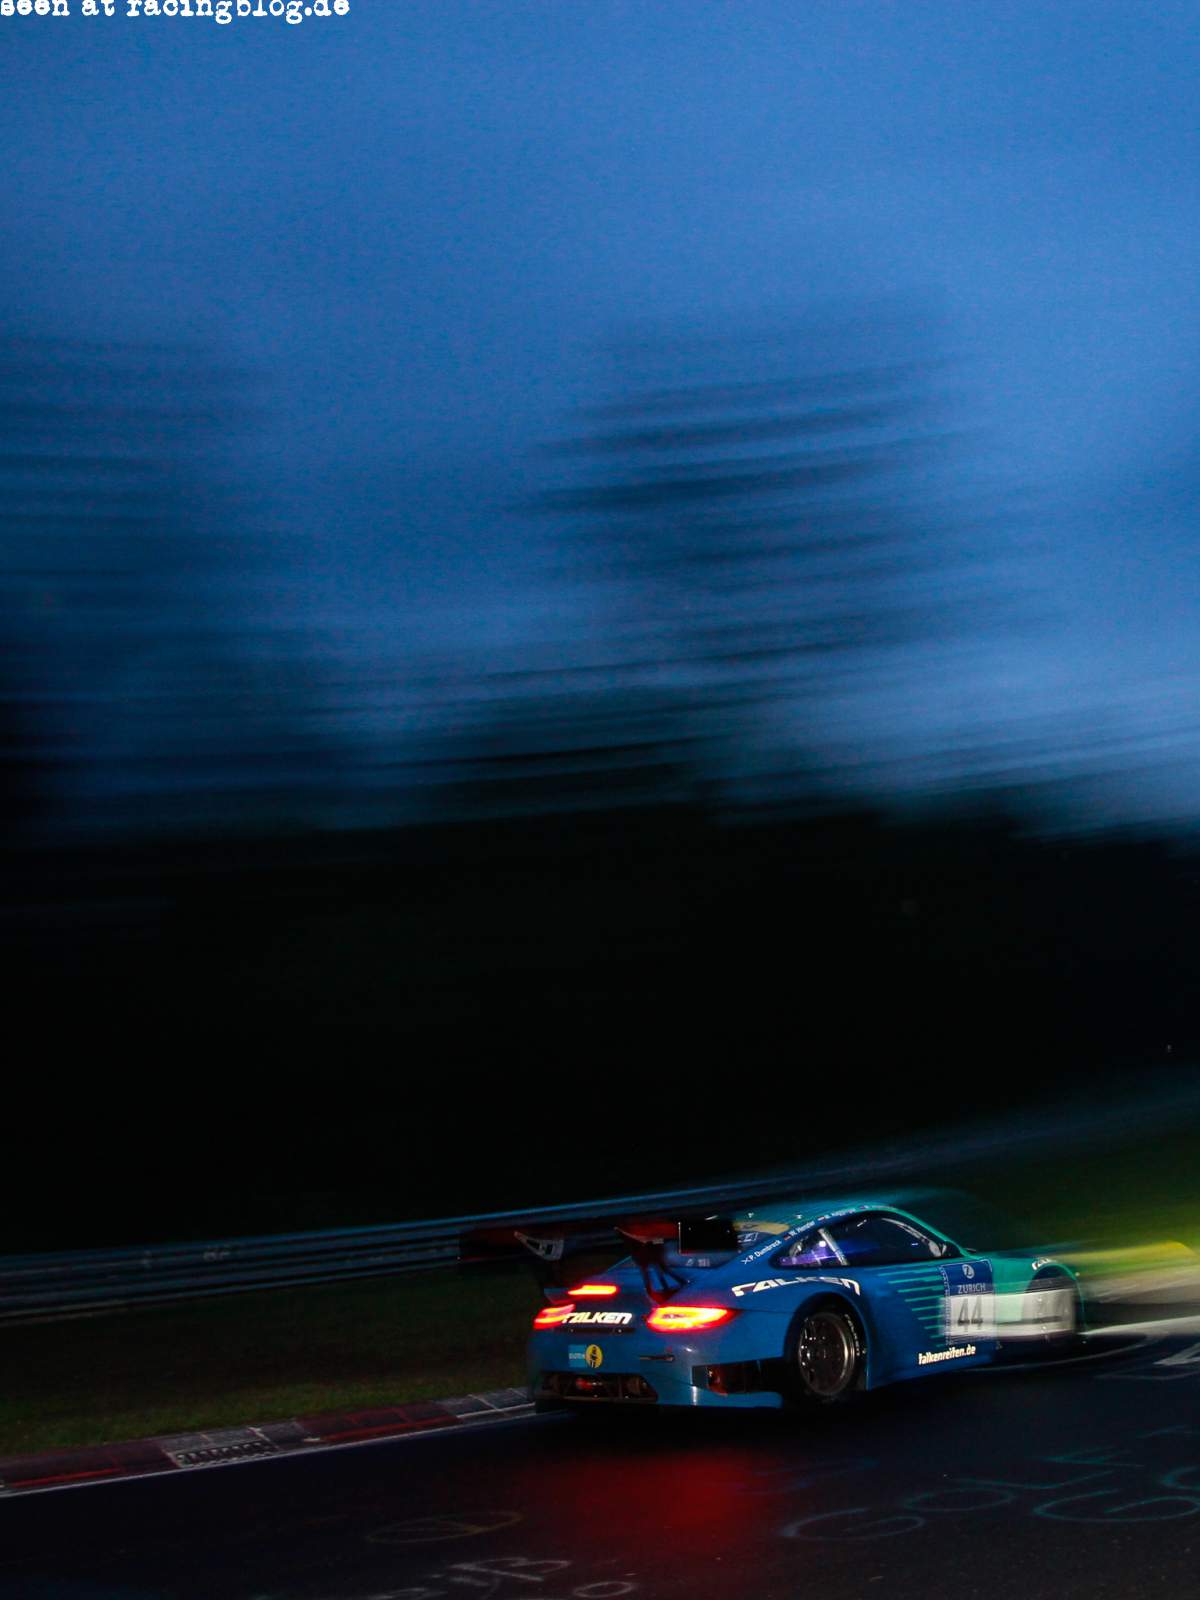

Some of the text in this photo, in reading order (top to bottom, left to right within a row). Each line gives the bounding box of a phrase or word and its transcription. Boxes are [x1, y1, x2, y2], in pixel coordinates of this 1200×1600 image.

[731, 1276, 861, 1297] FALKEN
[958, 1297, 984, 1331] 44
[918, 1343, 977, 1366] falkenreifen.de
